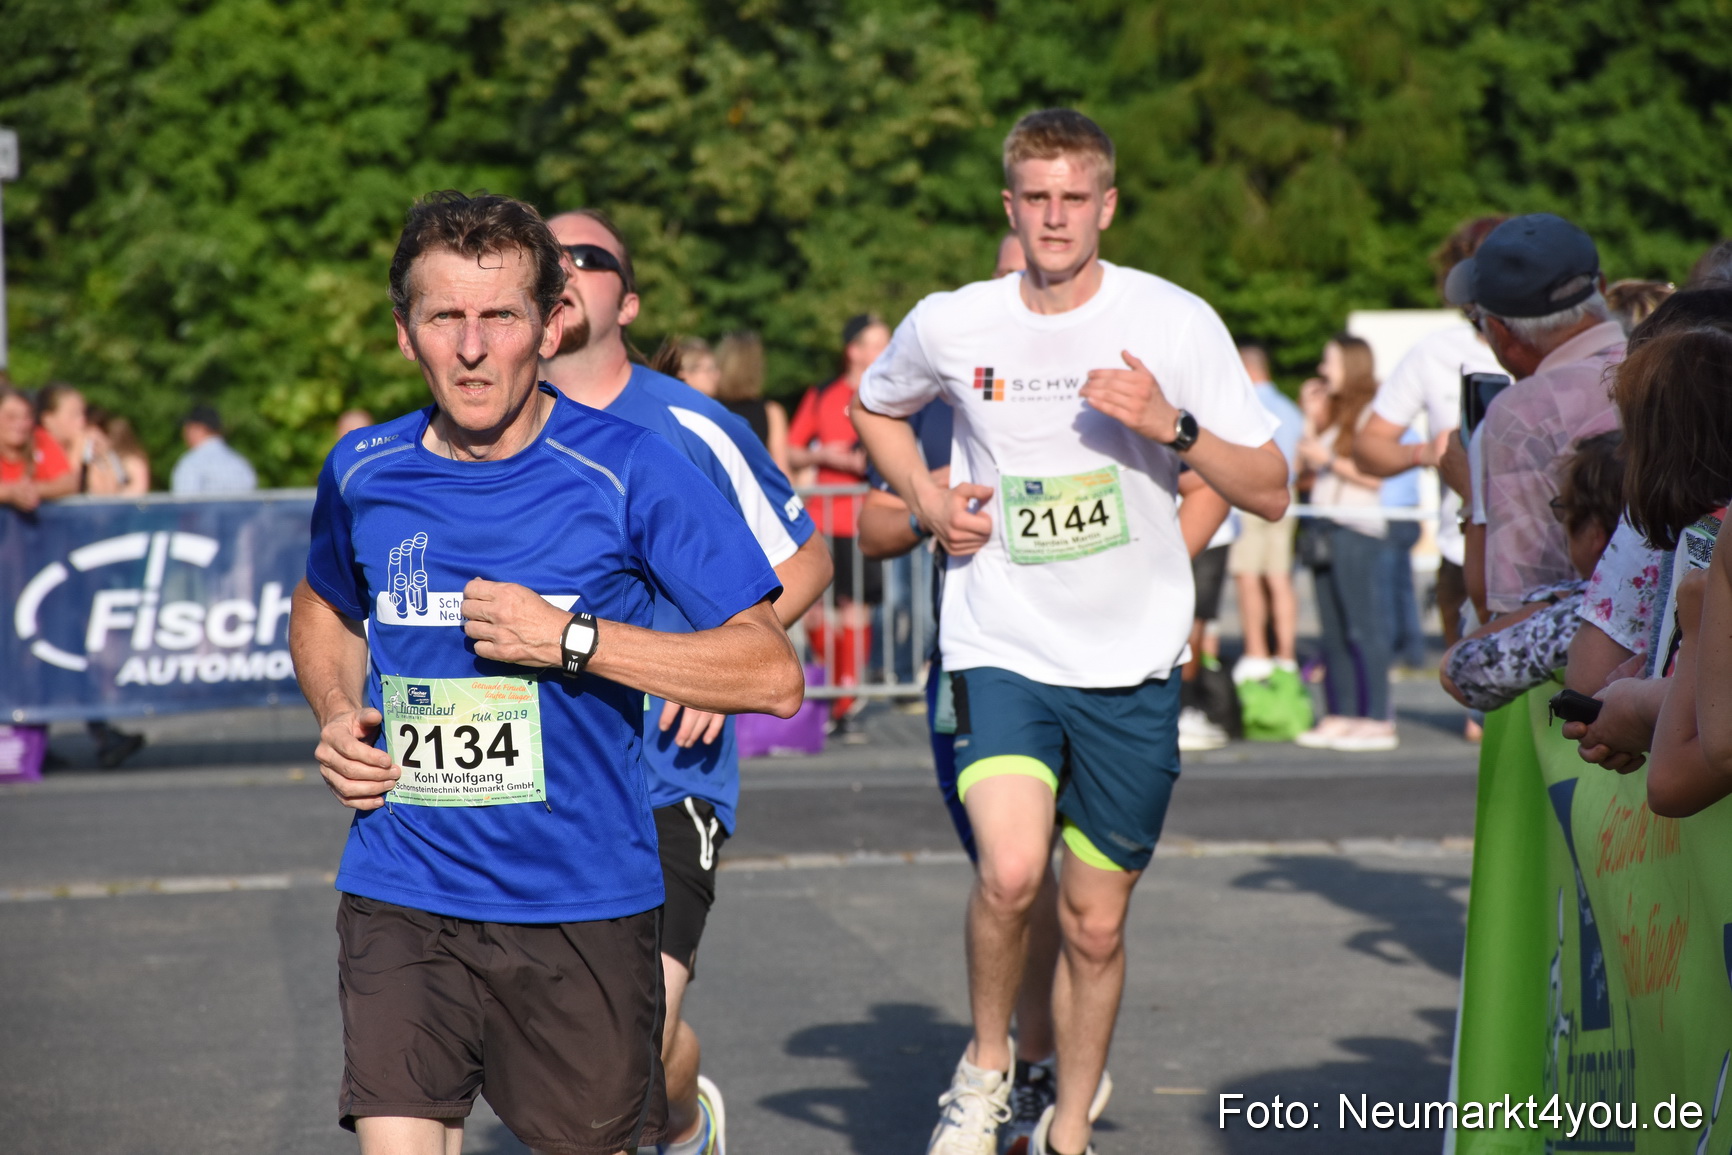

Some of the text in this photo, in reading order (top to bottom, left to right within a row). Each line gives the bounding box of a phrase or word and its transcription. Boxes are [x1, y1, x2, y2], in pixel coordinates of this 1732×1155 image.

[1010, 395, 1073, 403] COMPUTER
[370, 434, 400, 448] JAKO
[1018, 499, 1110, 538] 2144
[1071, 532, 1101, 544] Martin
[400, 701, 456, 716] firmenlauf
[471, 709, 529, 723] run 2019
[399, 722, 519, 770] 2134
[414, 772, 503, 786] Kohl Wolfgang
[395, 781, 535, 794] Schornsteintechnik Neumarkt GmbH
